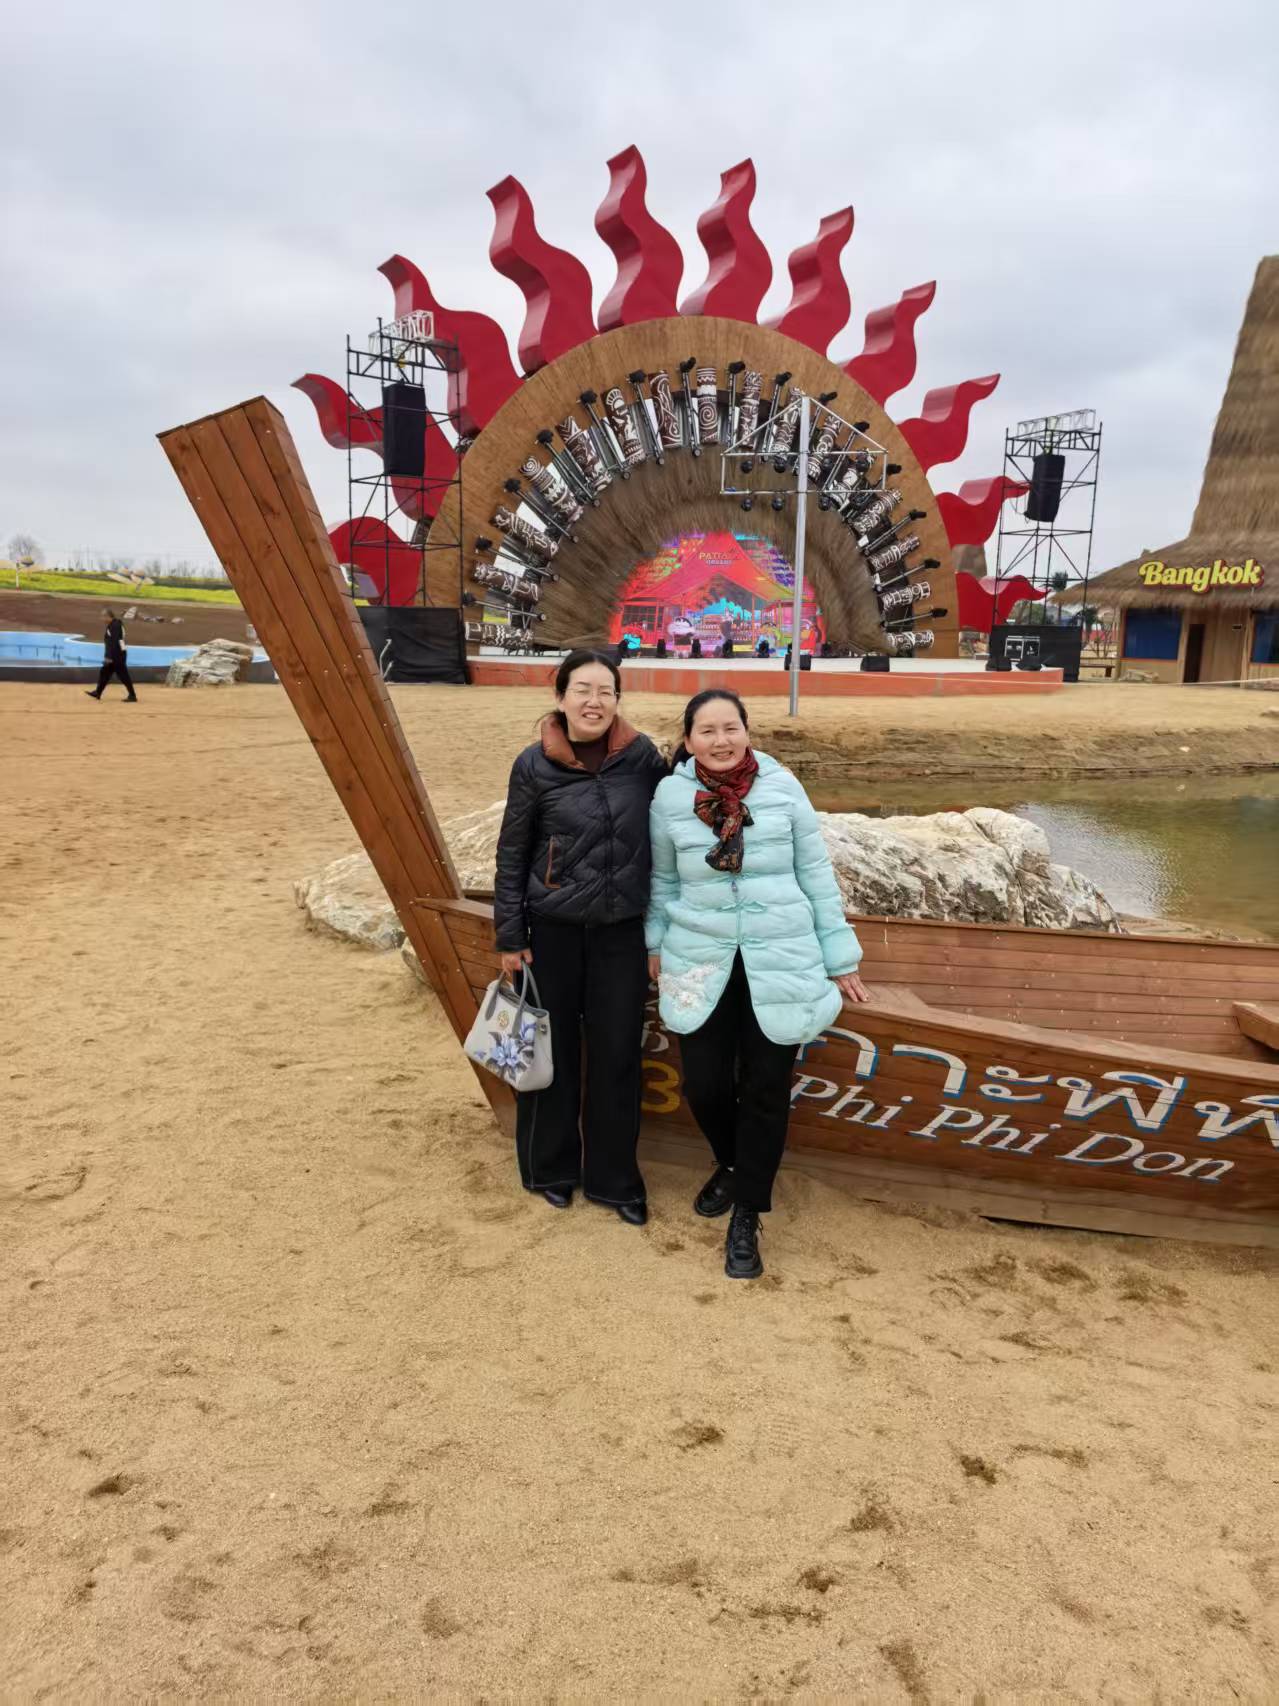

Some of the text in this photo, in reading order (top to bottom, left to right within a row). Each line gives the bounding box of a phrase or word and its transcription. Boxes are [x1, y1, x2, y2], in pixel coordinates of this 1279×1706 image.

[1138, 559, 1263, 593] Bangkok
[790, 1072, 1235, 1183] Phi Phi Don
